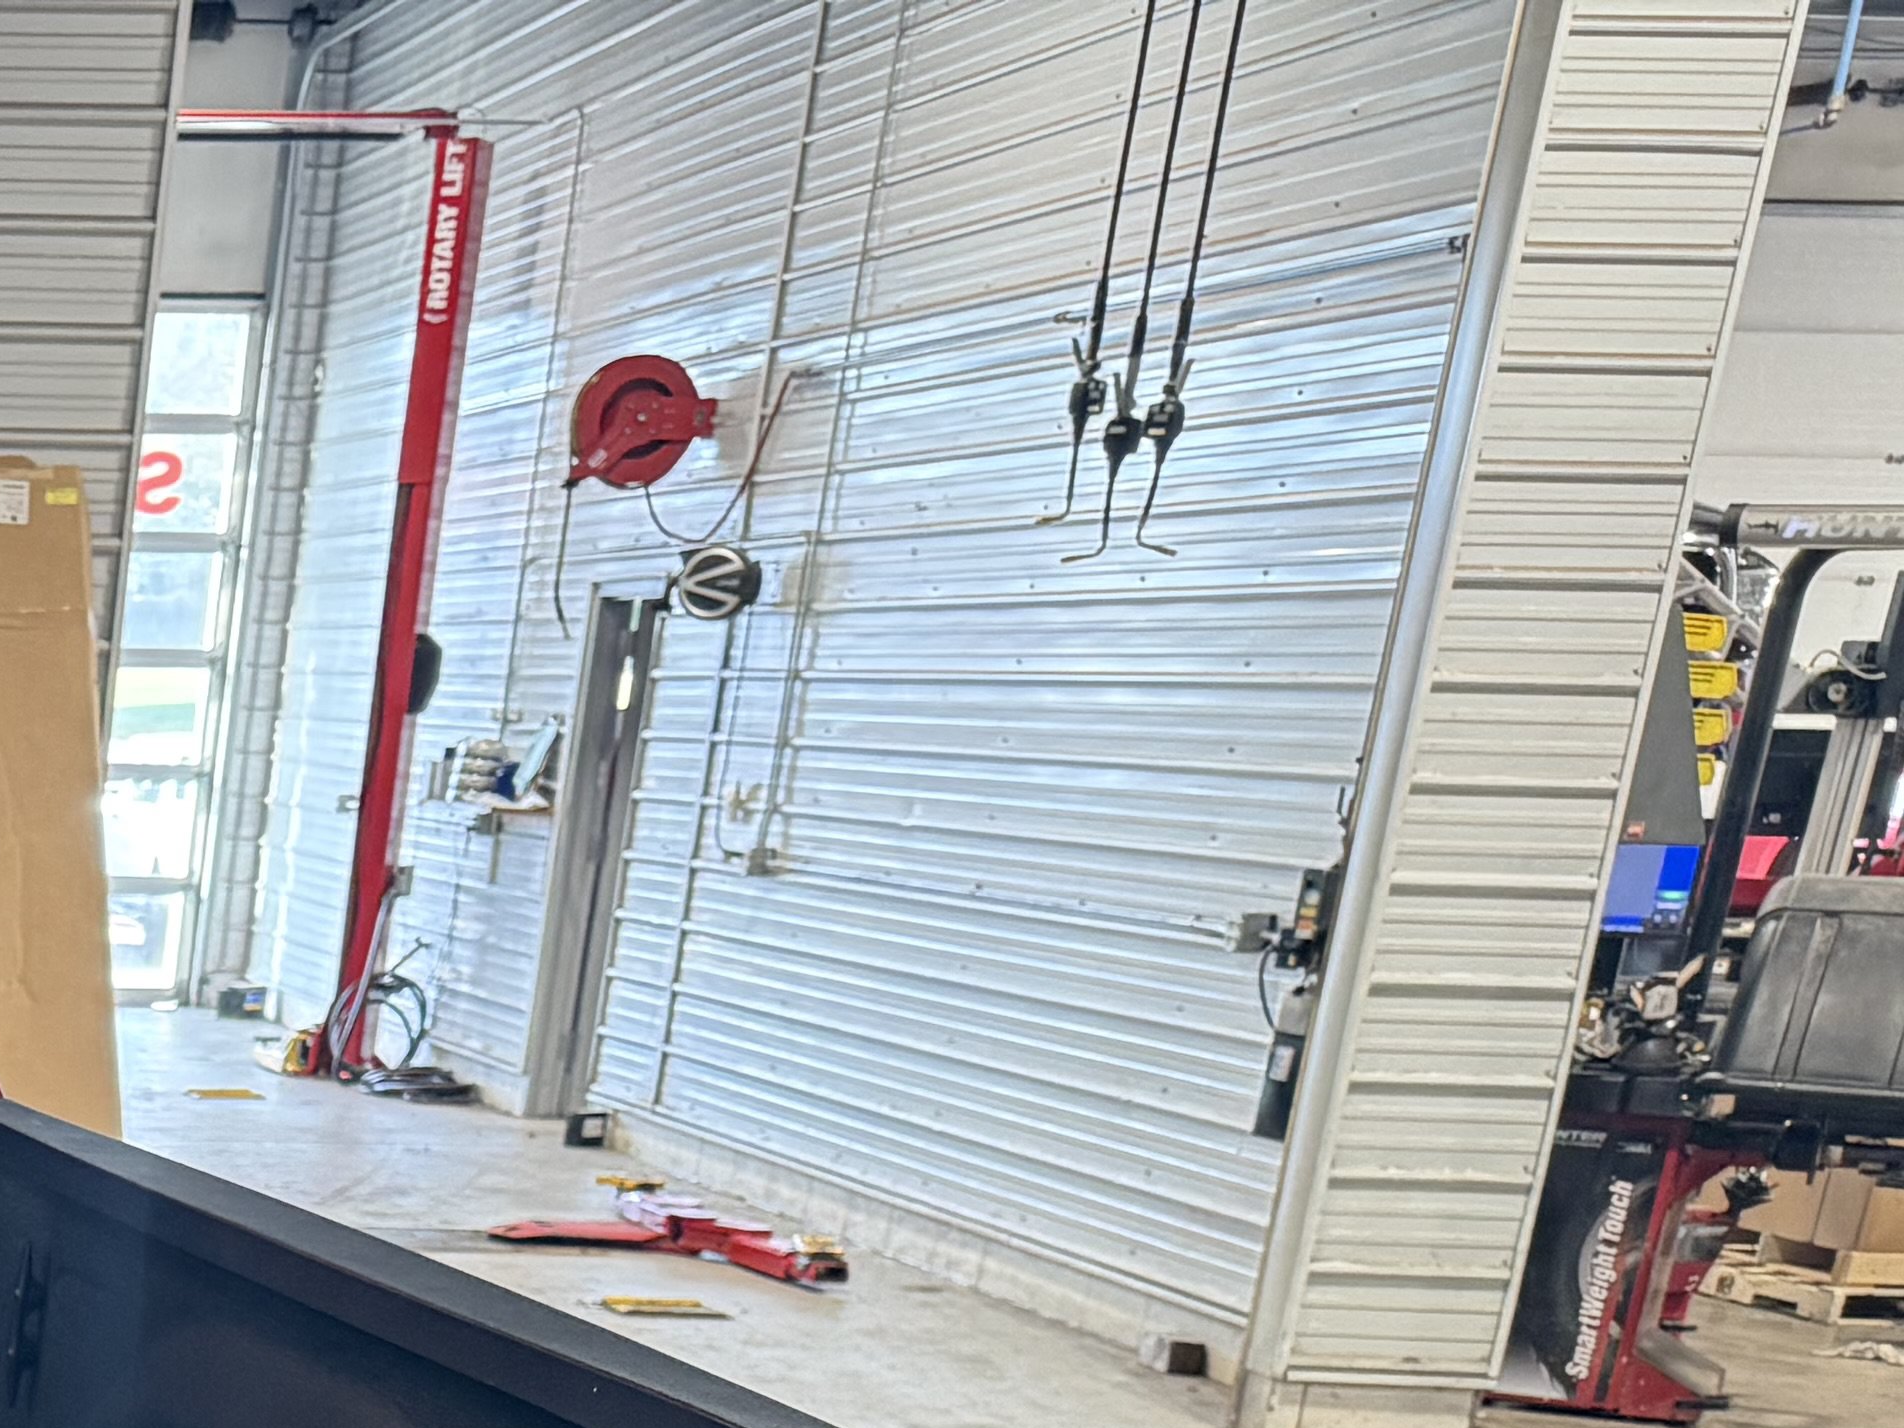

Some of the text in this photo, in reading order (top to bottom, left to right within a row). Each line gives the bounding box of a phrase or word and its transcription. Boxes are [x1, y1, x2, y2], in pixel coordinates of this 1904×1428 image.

[425, 138, 468, 310] ROTARY LIFT
[1565, 1244, 1618, 1381] SmartWeight
[1598, 1180, 1634, 1243] Touch
